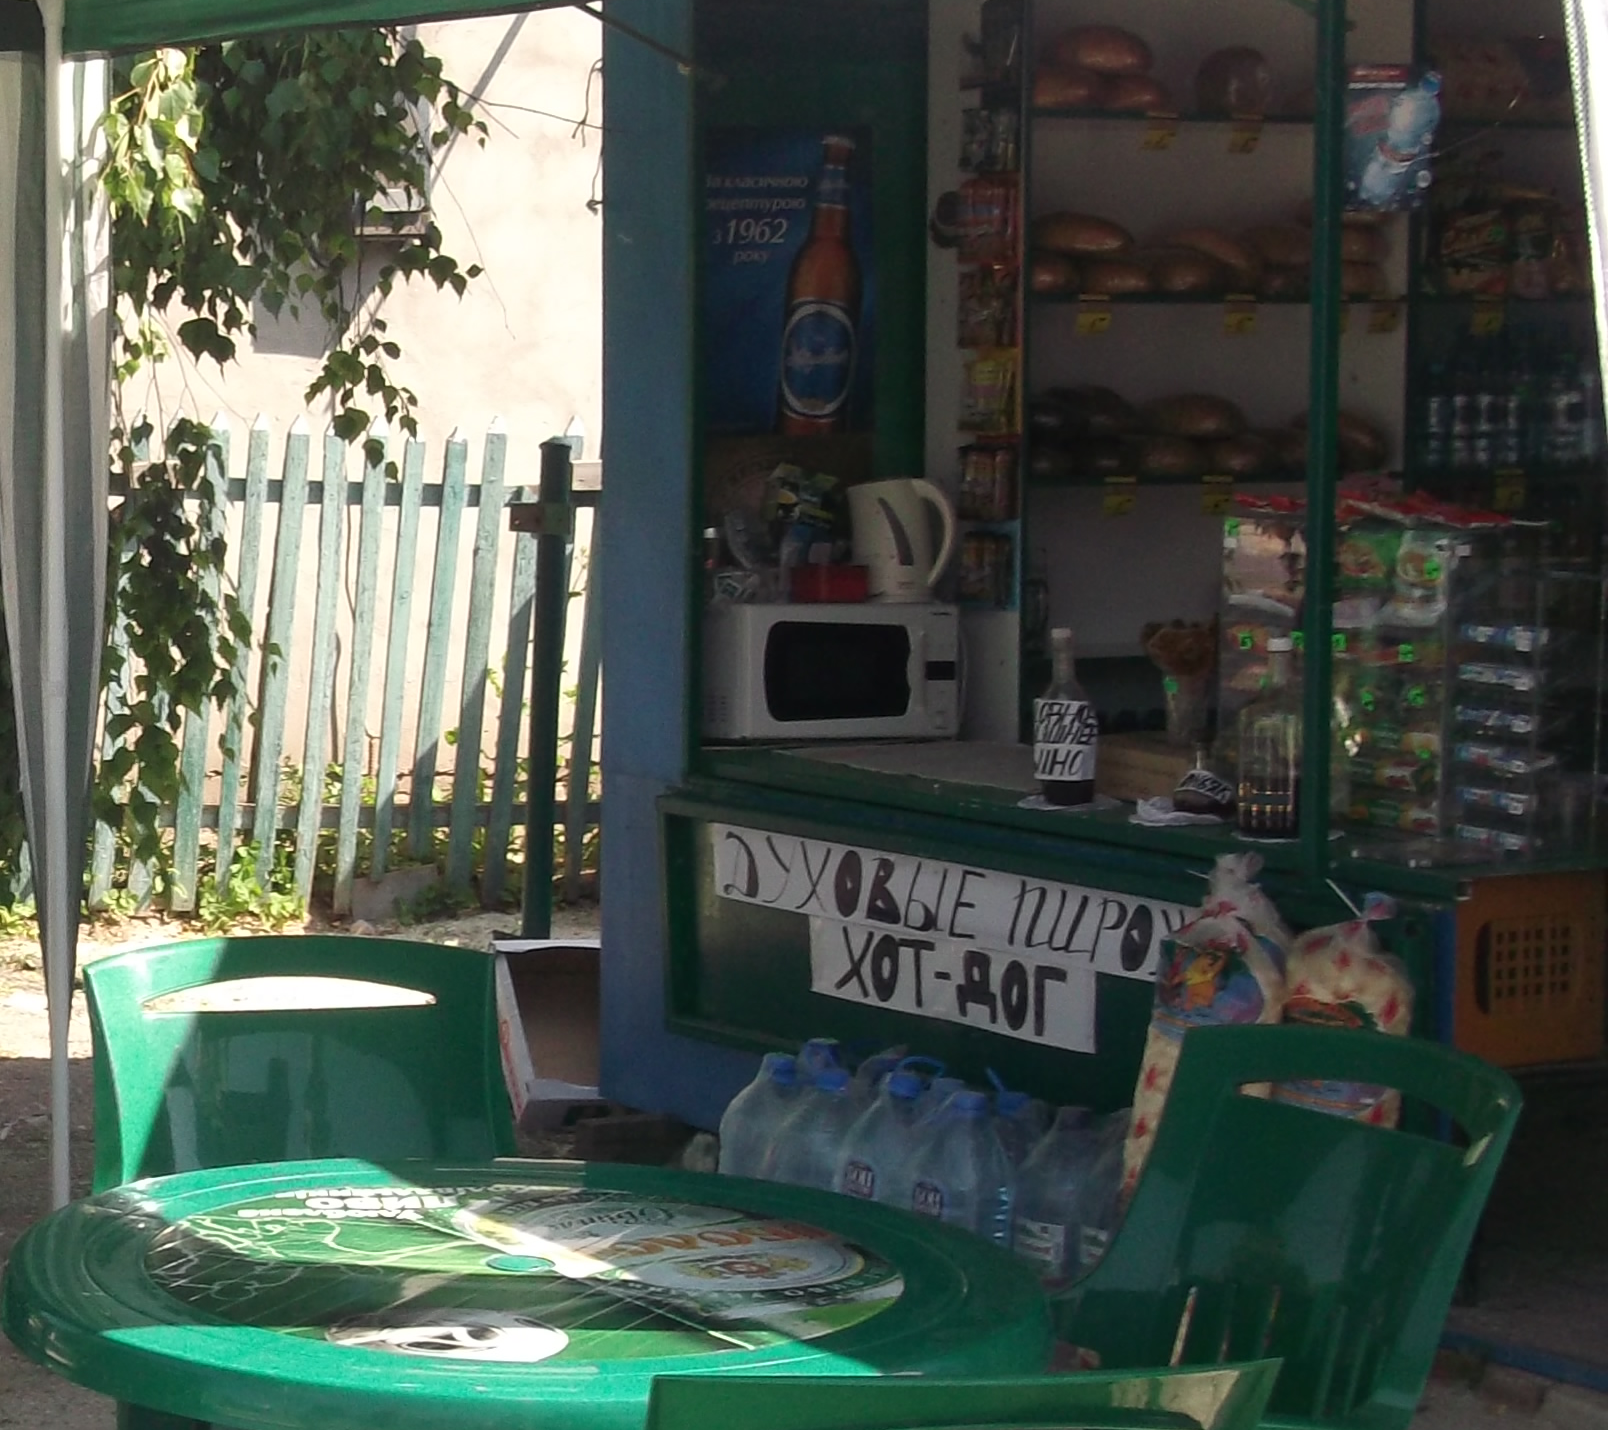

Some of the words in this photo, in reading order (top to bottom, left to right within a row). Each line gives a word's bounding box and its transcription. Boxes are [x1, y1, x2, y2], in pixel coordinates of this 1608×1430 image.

[725, 217, 789, 245] 1962
[733, 249, 768, 266] року
[724, 829, 986, 940] ДУХОВЫЕ
[834, 924, 1068, 1038] ХОТ-ДОГ
[304, 1195, 459, 1210] ПИВО
